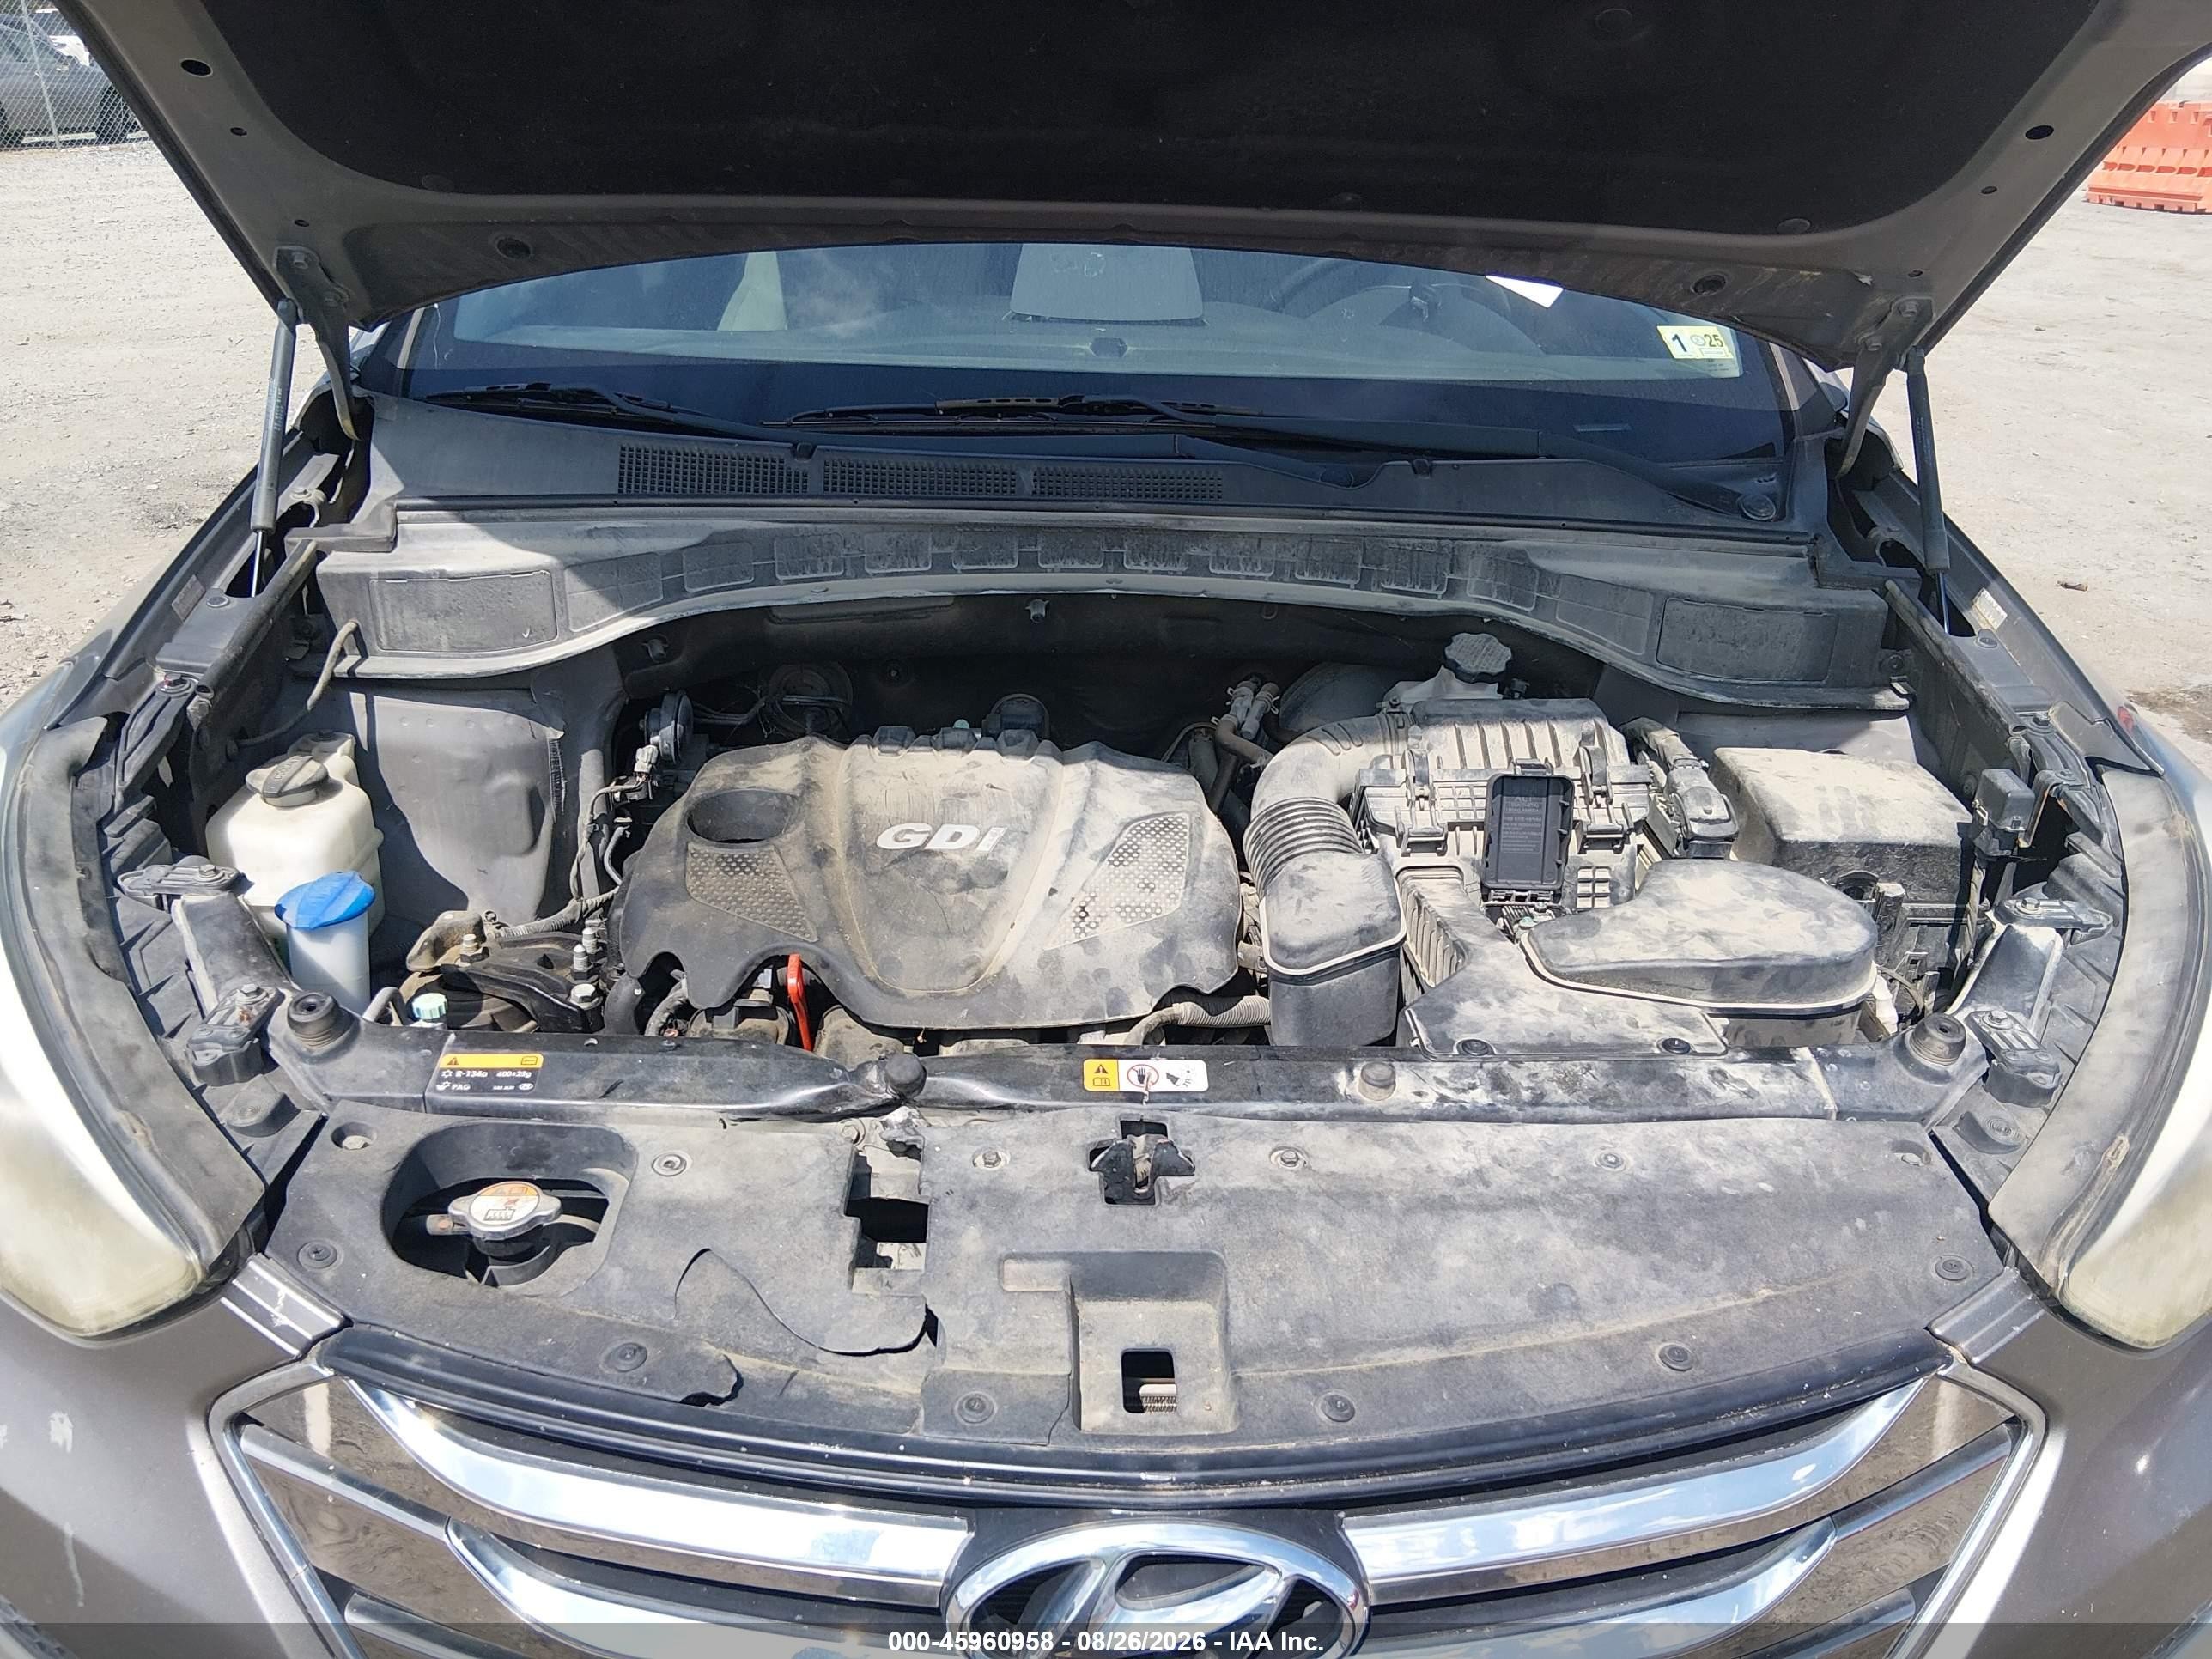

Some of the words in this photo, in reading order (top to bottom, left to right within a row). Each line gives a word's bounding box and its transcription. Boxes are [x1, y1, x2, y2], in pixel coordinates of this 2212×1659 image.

[1672, 333, 1687, 352] 1
[1704, 333, 1723, 348] 25
[876, 822, 1008, 852] GDI
